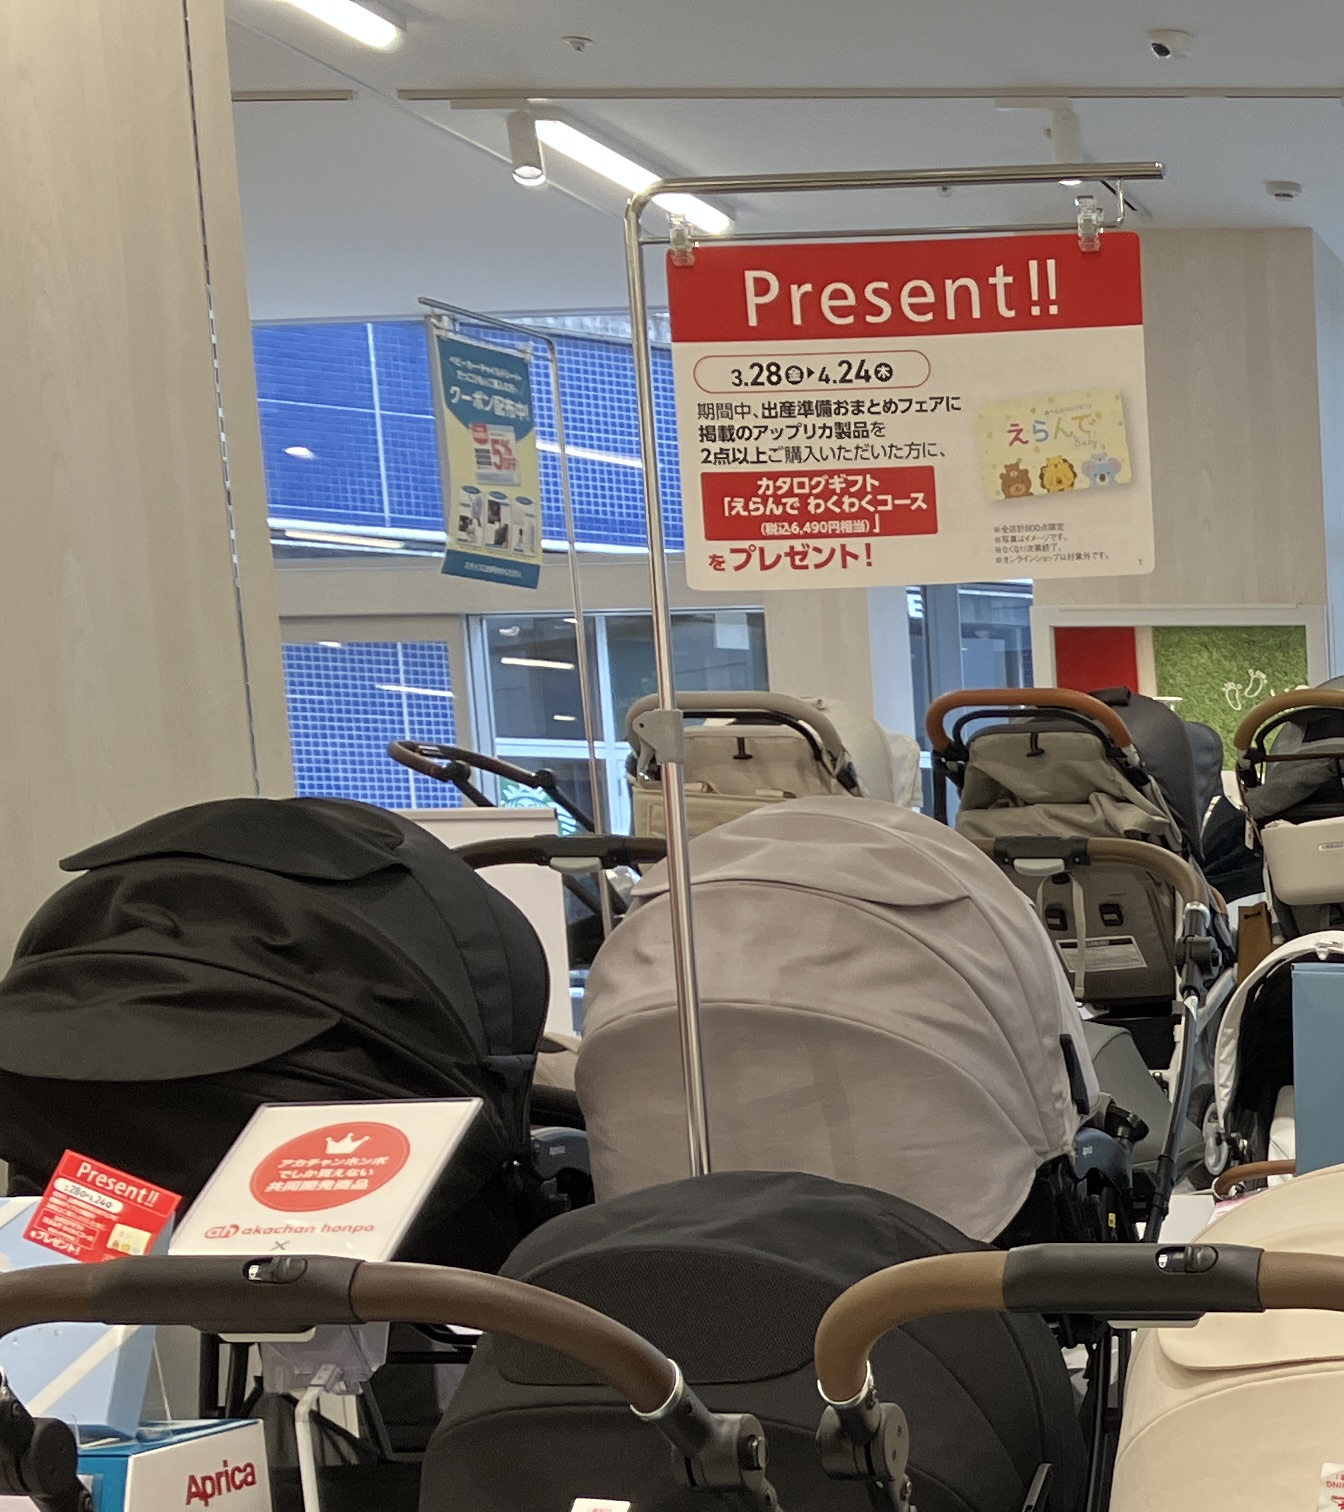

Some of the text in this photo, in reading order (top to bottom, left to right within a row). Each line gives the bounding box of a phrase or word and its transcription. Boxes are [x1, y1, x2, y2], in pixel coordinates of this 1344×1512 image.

[743, 258, 1060, 327] Present!!
[697, 396, 961, 421] 期間中、出産準備おまとめフェアに
[699, 421, 886, 443] 掲載のアップリカ製品を
[1007, 413, 1096, 446] えらんで
[1073, 435, 1098, 449] Baby
[701, 442, 946, 465] 2点以上ご購入いただいた方に、
[757, 474, 880, 495] カタログギフト
[278, 1156, 389, 1168] アカチャンホンポ
[279, 1168, 374, 1178] でしか買えない
[76, 1162, 161, 1208] Present!!
[265, 1179, 369, 1192] 共同開発商品
[241, 1223, 375, 1235] akachan honpo
[185, 1459, 257, 1507] Aprica
